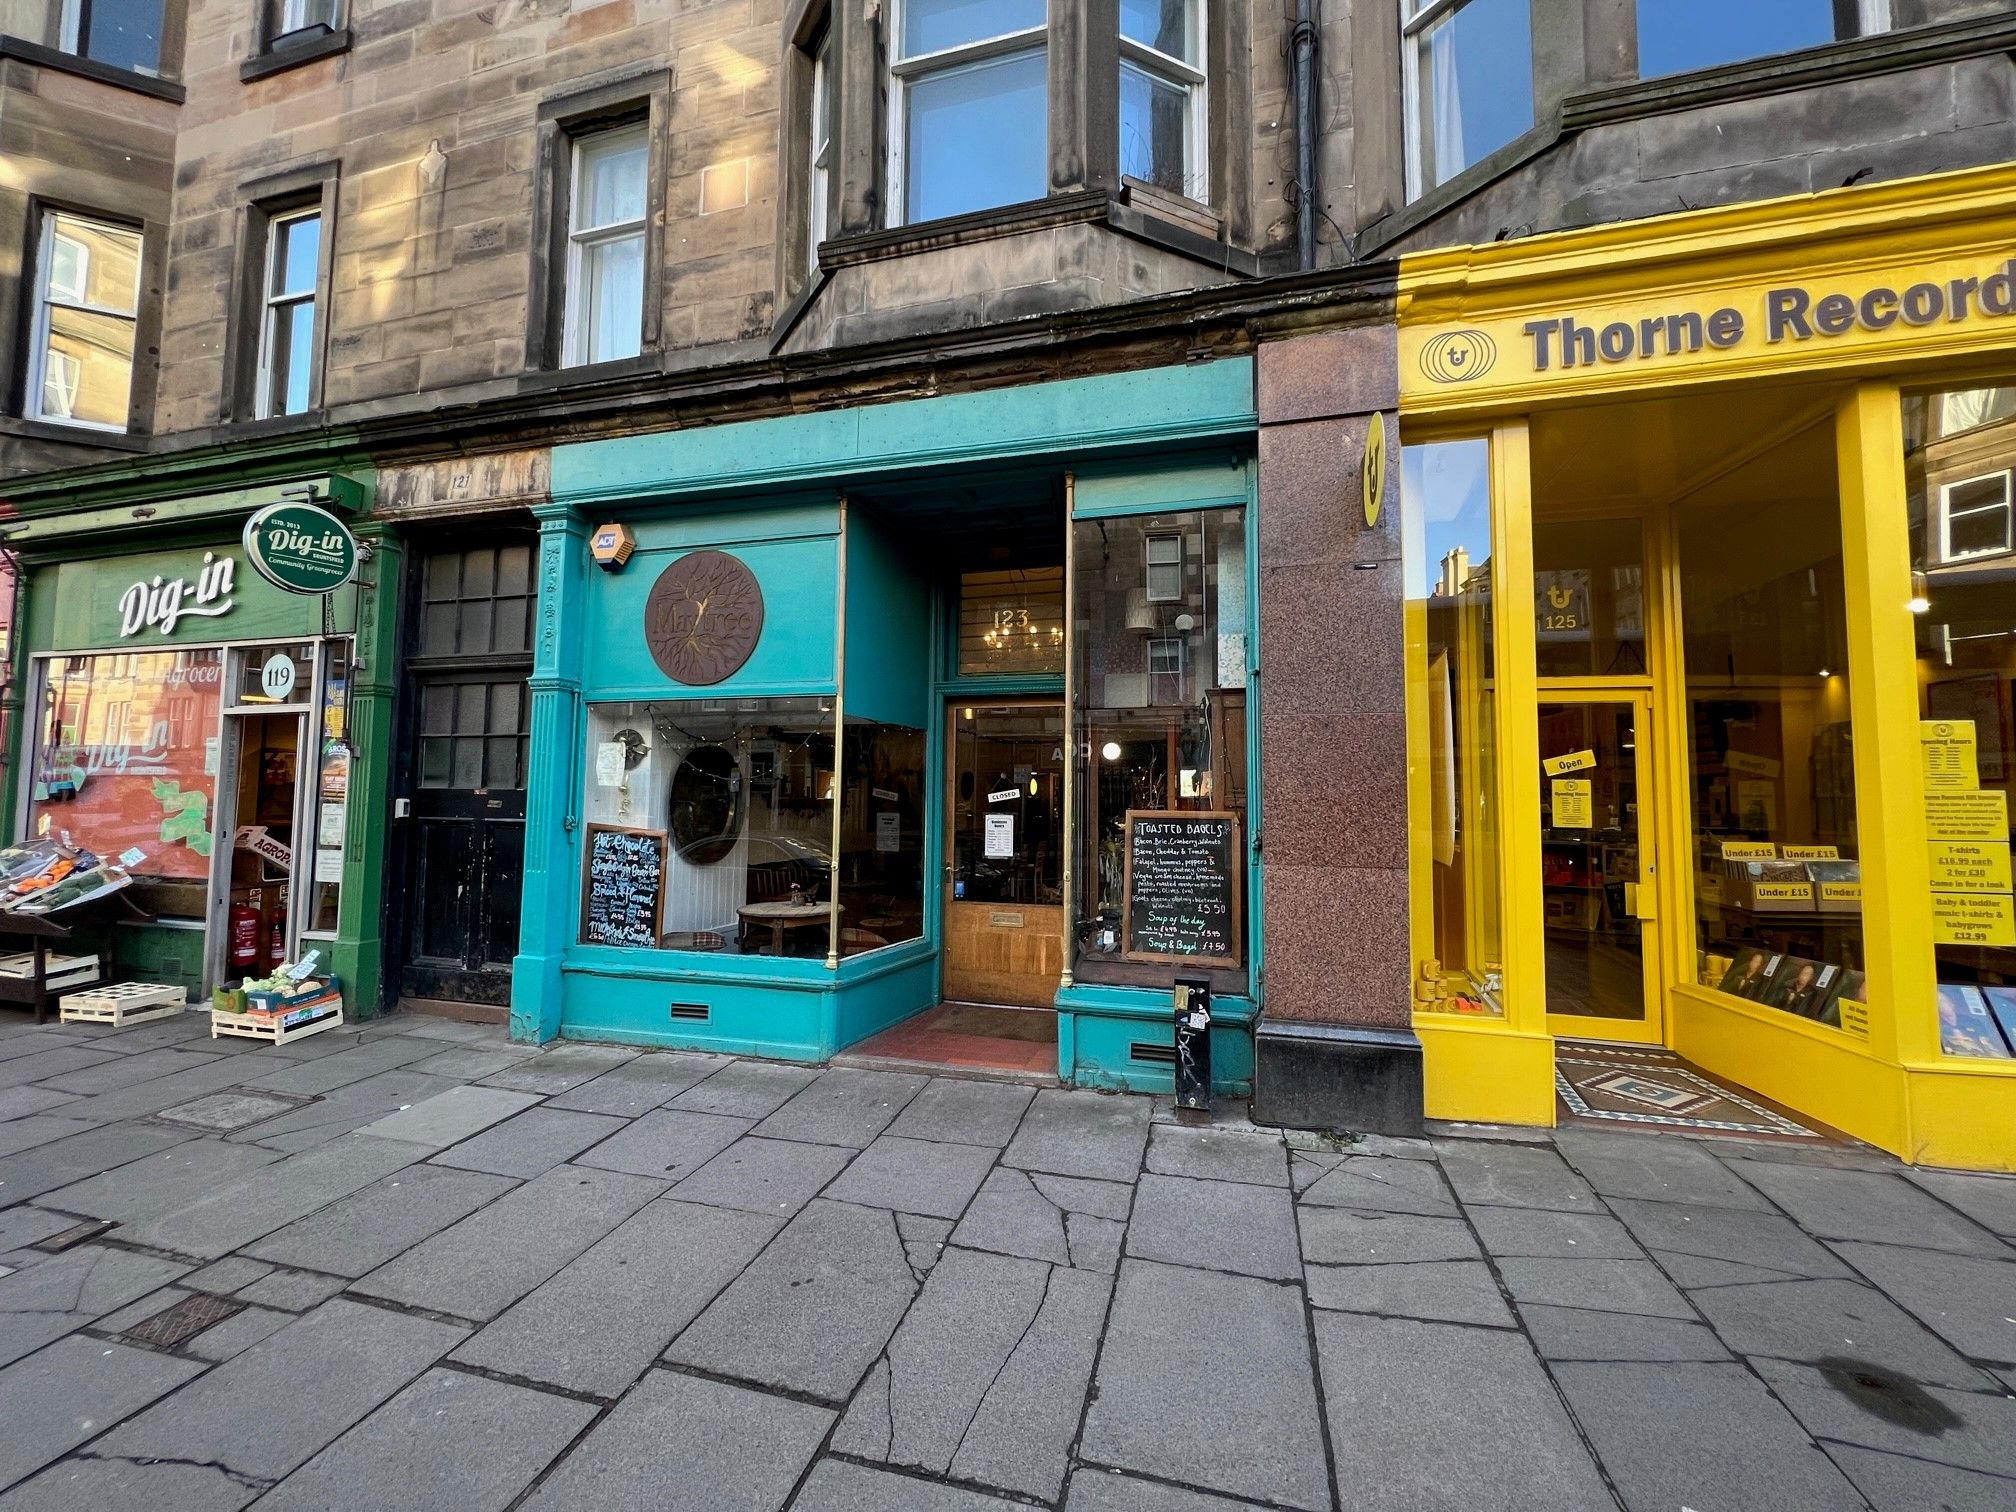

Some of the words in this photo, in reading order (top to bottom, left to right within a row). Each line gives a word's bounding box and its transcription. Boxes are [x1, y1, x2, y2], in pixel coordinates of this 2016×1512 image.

[1522, 307, 1745, 372] Thorne
[1765, 258, 2016, 344] Record
[453, 475, 470, 489] 121
[268, 528, 344, 556] Dig-in
[598, 536, 615, 546] ADT
[268, 556, 305, 571] Community
[118, 551, 235, 638] Dig-in
[994, 609, 1029, 629] 123
[1546, 614, 1577, 630] 125
[267, 666, 290, 687] 119
[1558, 759, 1583, 770] Open
[992, 791, 1017, 801] CLOSED
[1138, 822, 1182, 836] TOASTED
[1186, 824, 1223, 838] BAGELS
[253, 838, 291, 866] AGROP
[1725, 849, 1752, 857] Under
[1755, 849, 1773, 857] £15
[1786, 850, 1815, 858] Under
[1817, 850, 1837, 858] £15
[1929, 879, 1954, 887] Come
[1759, 888, 1788, 896] Under
[1791, 888, 1809, 896] £15
[1825, 888, 1854, 896] Under
[1936, 898, 1957, 907] Baby
[1148, 910, 1168, 925] Soup
[1169, 916, 1178, 926] of
[1190, 915, 1206, 931] day
[1148, 937, 1167, 951] Soup
[1168, 939, 1174, 949] &
[1176, 939, 1197, 954] Bagel
